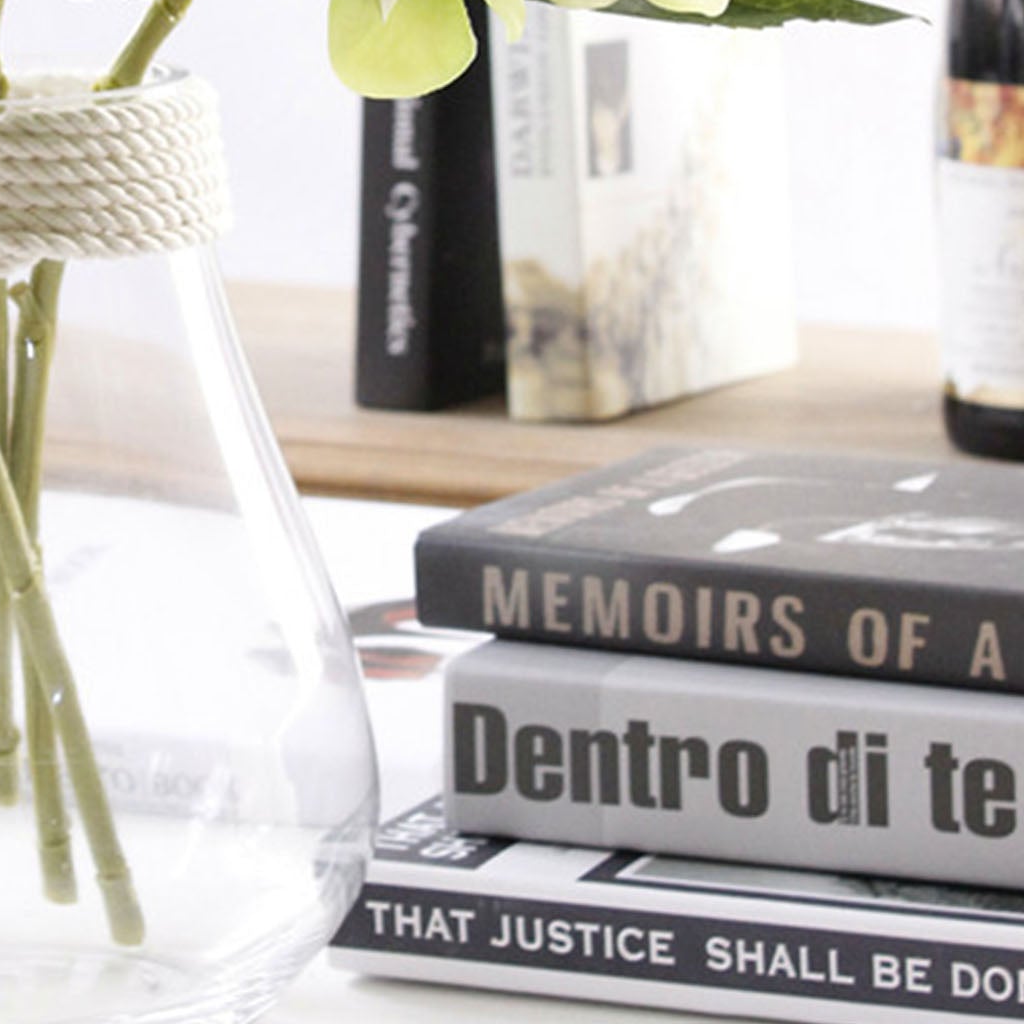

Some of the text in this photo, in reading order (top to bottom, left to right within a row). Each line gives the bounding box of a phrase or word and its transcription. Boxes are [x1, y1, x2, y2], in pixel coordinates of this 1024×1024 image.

[483, 567, 1006, 680] MEMOIRS OF A
[453, 701, 770, 820] Dentro
[807, 730, 889, 828] di
[924, 741, 1018, 839] te
[366, 901, 1024, 1006] THAT JUSTICE SHALL BE DO
